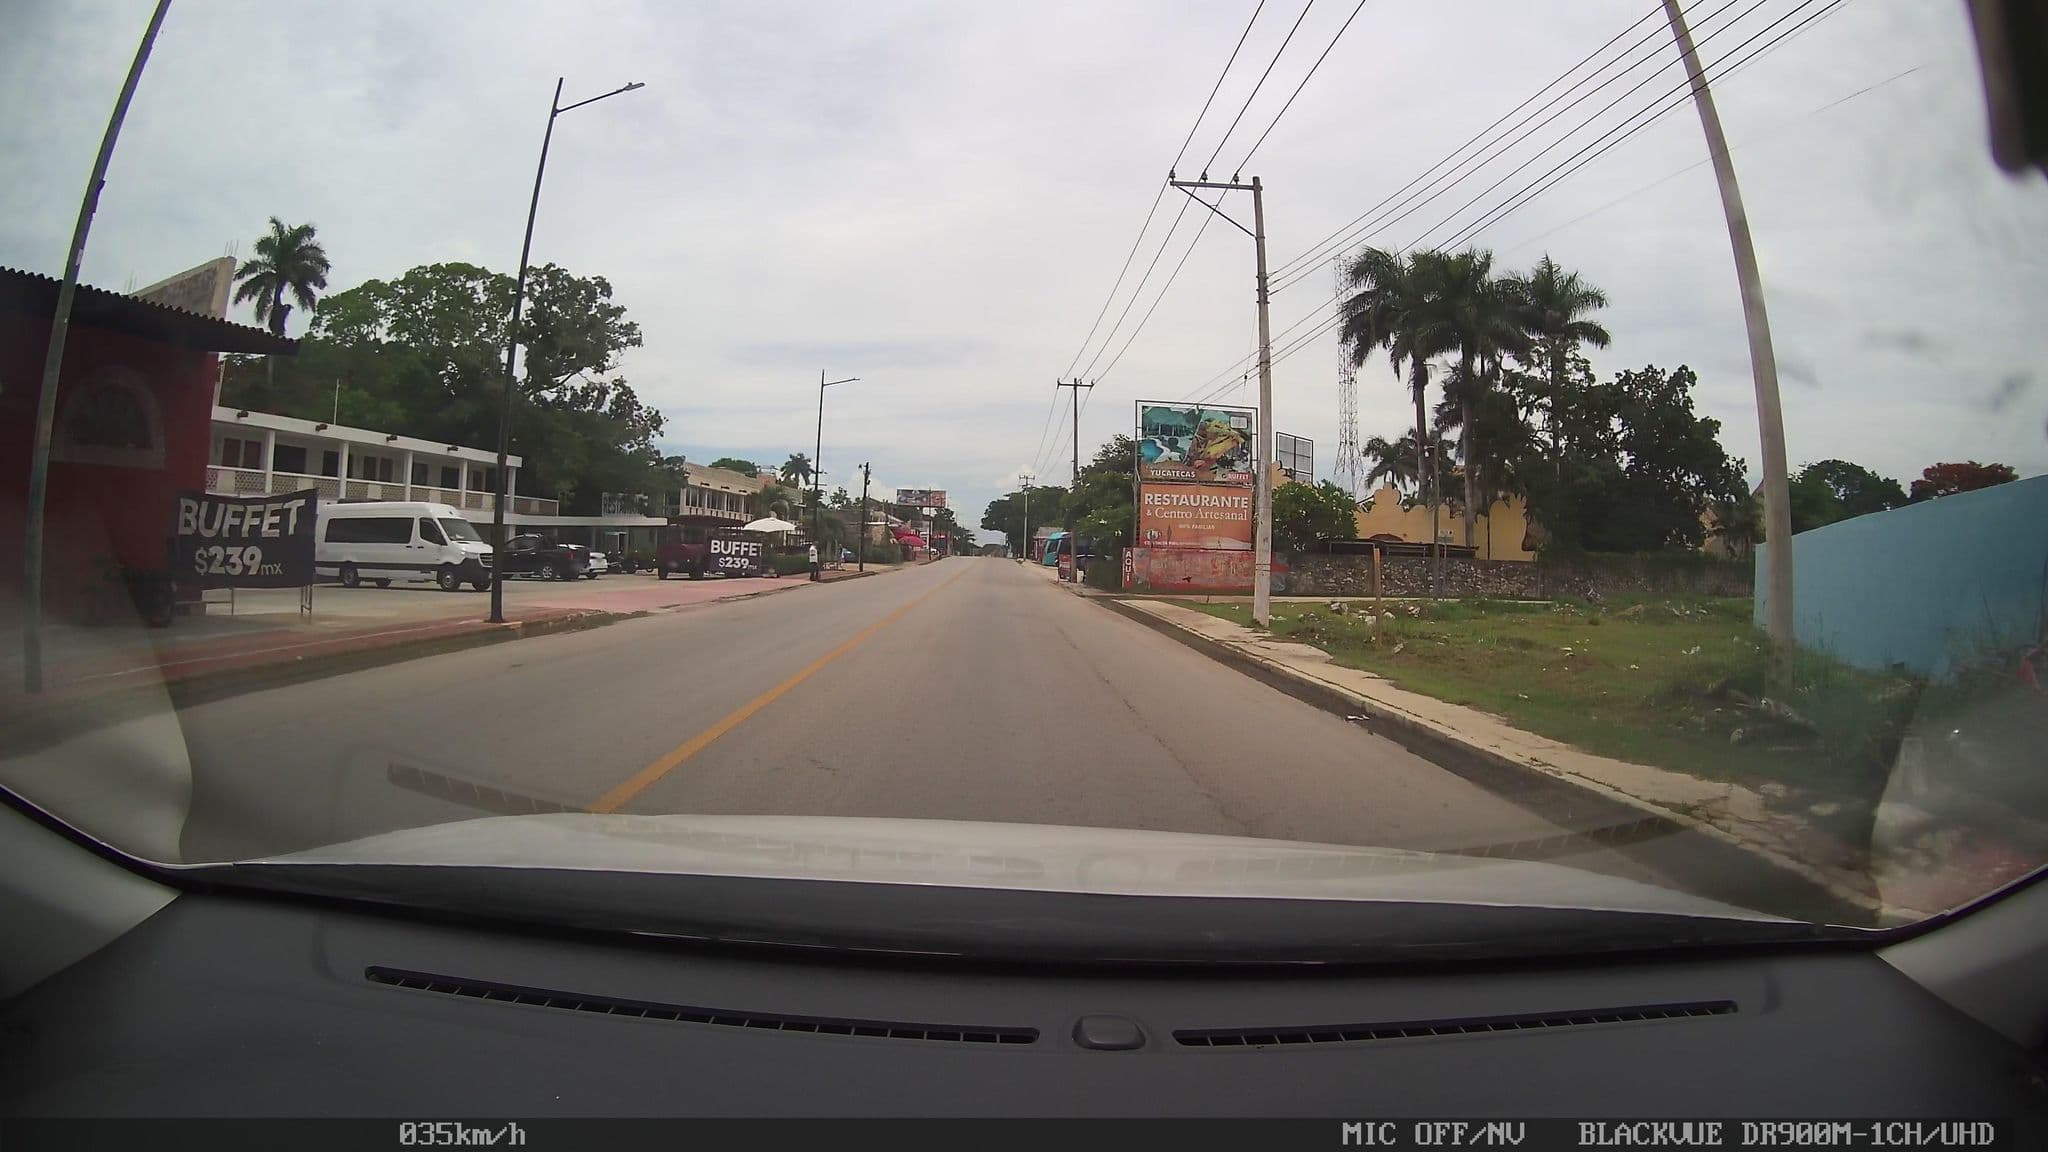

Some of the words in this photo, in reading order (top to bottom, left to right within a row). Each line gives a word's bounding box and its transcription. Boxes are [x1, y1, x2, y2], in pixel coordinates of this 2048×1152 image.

[1150, 469, 1196, 478] YUCATECAS
[1144, 493, 1249, 509] RESTAURANTE
[178, 498, 306, 538] BUFFET
[1155, 507, 1193, 519] Centro
[1195, 508, 1247, 521] Artesanal
[710, 539, 763, 557] BUFFET
